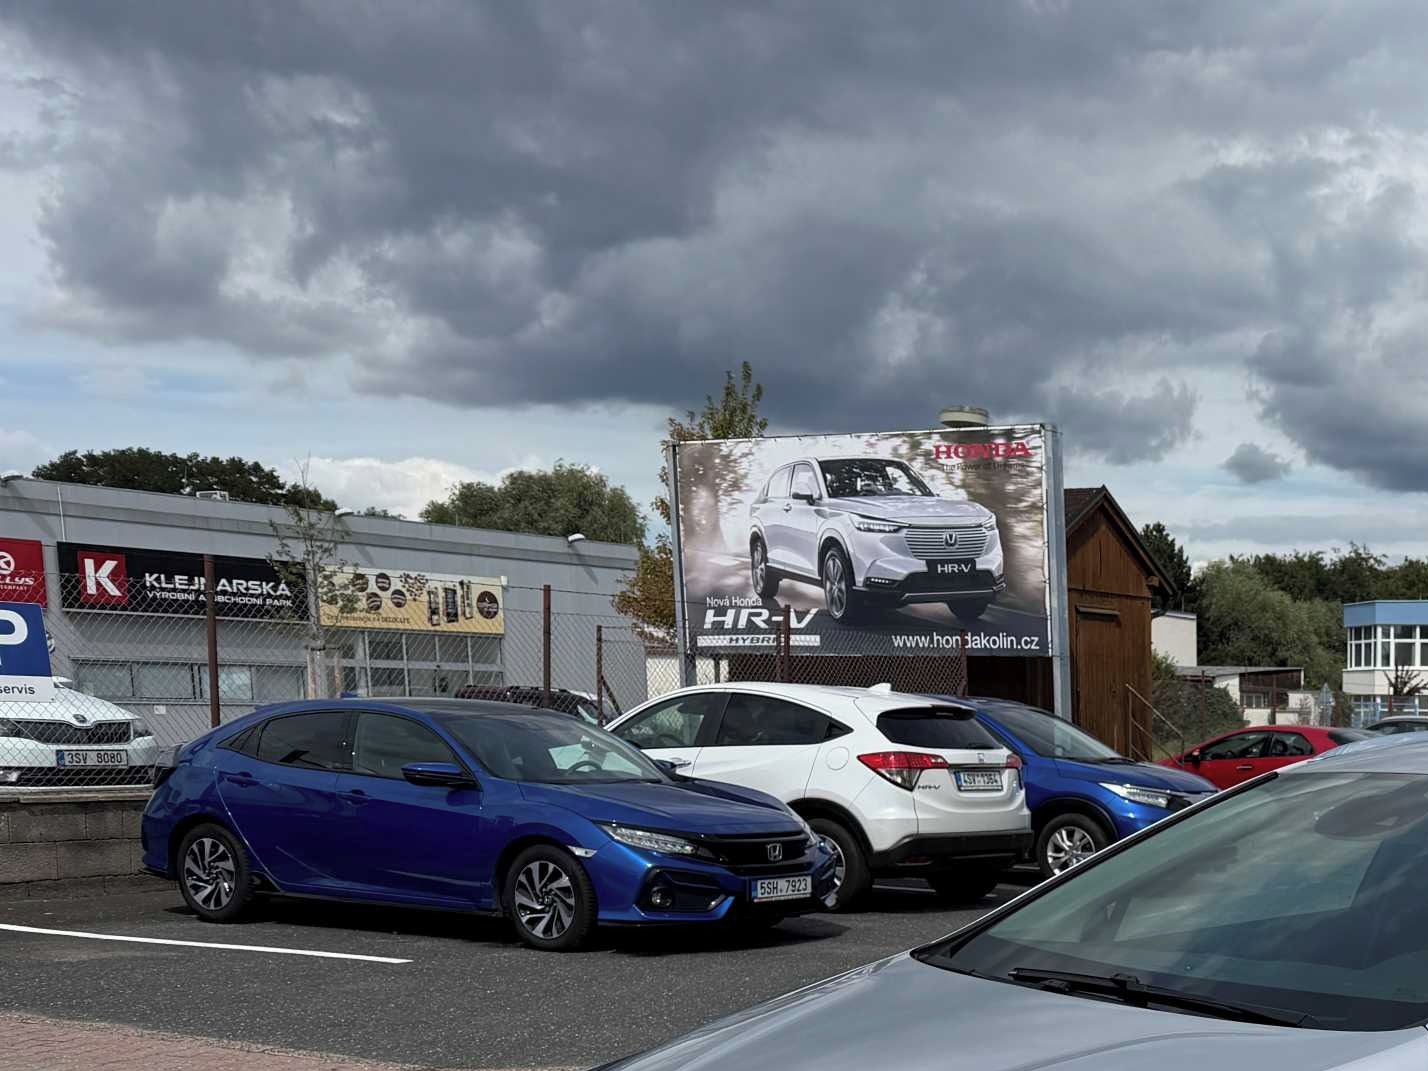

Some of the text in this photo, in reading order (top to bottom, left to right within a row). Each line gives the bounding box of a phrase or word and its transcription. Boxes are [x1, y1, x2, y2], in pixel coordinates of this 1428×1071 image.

[933, 442, 1033, 460] HONDA
[84, 558, 122, 596] K
[146, 589, 195, 600] VÝROBNÍ
[266, 599, 293, 607] PARK
[706, 596, 762, 607] Nová Honda
[703, 608, 819, 629] HR-V
[892, 632, 1040, 650] www.hondakolin.cz
[760, 878, 808, 895] 5SH 7923
